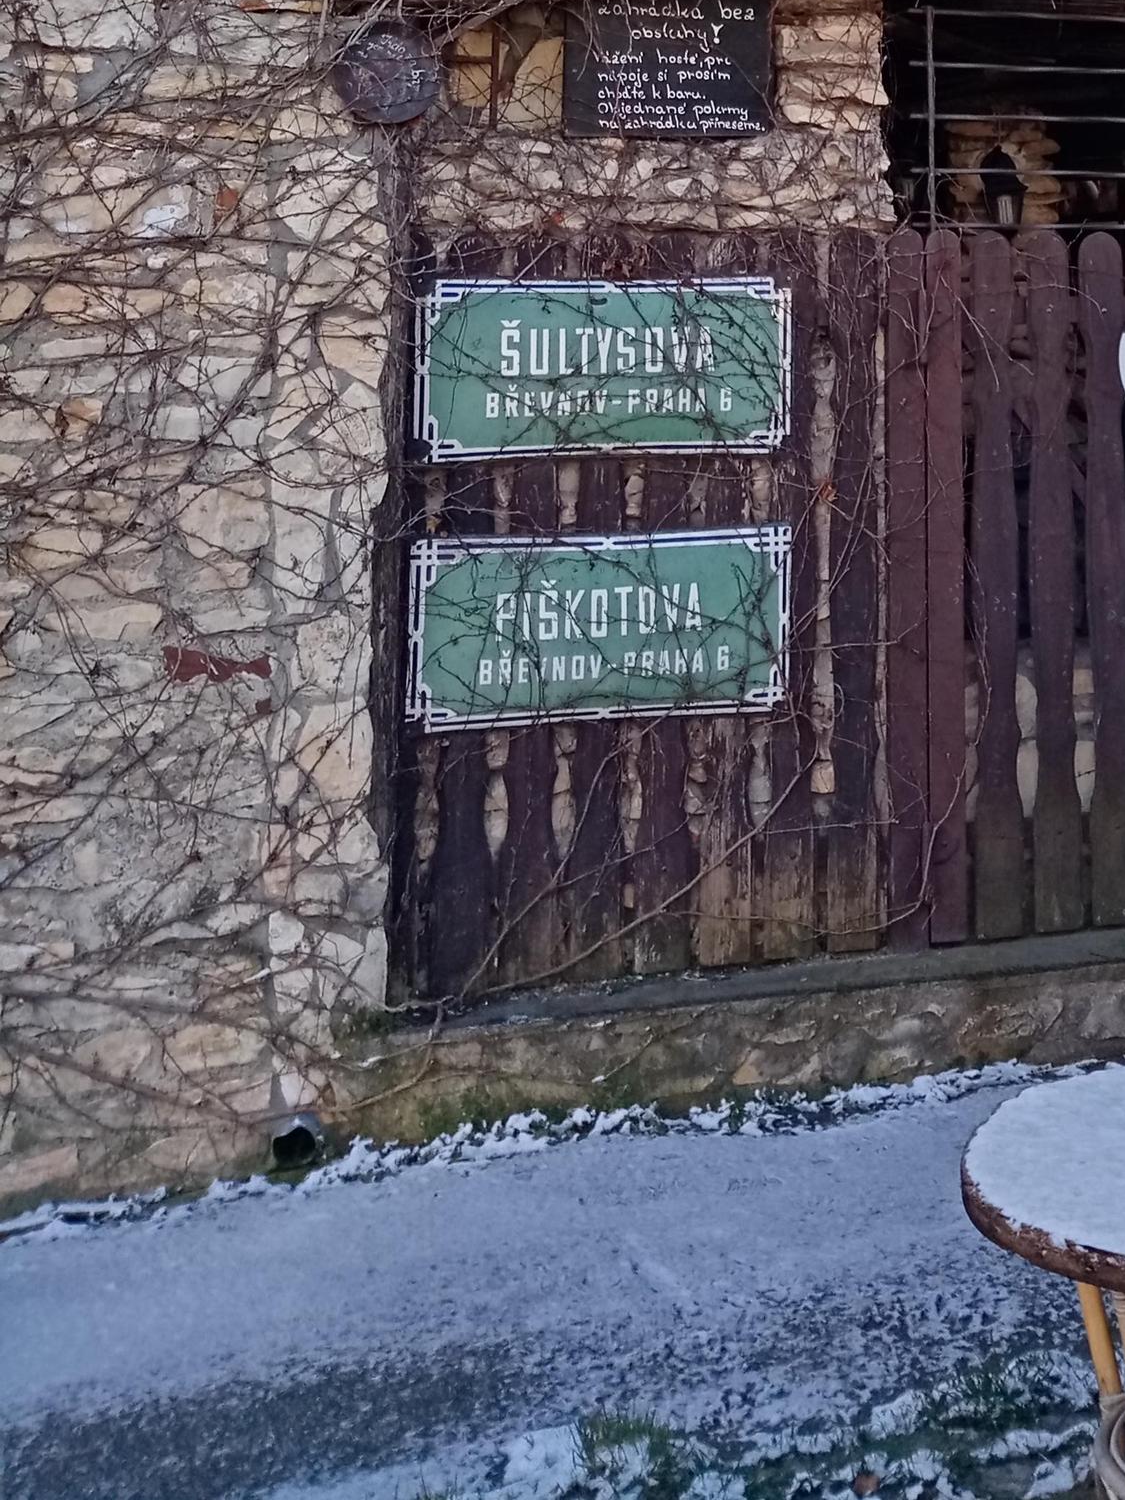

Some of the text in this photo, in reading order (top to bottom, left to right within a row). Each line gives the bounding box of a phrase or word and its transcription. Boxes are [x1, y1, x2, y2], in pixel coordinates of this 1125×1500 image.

[719, 0, 755, 21] bez
[631, 22, 724, 54] obsluhy!
[657, 69, 668, 81] si
[677, 69, 731, 83] prosím
[652, 83, 661, 99] k
[666, 83, 706, 100] baru.
[692, 99, 749, 121] pokrmy
[598, 119, 619, 130] na
[500, 319, 716, 377] ŠULTYSOVA
[719, 387, 733, 413] 6
[495, 579, 702, 642] PIŠKOTOVA
[716, 645, 730, 671] 6
